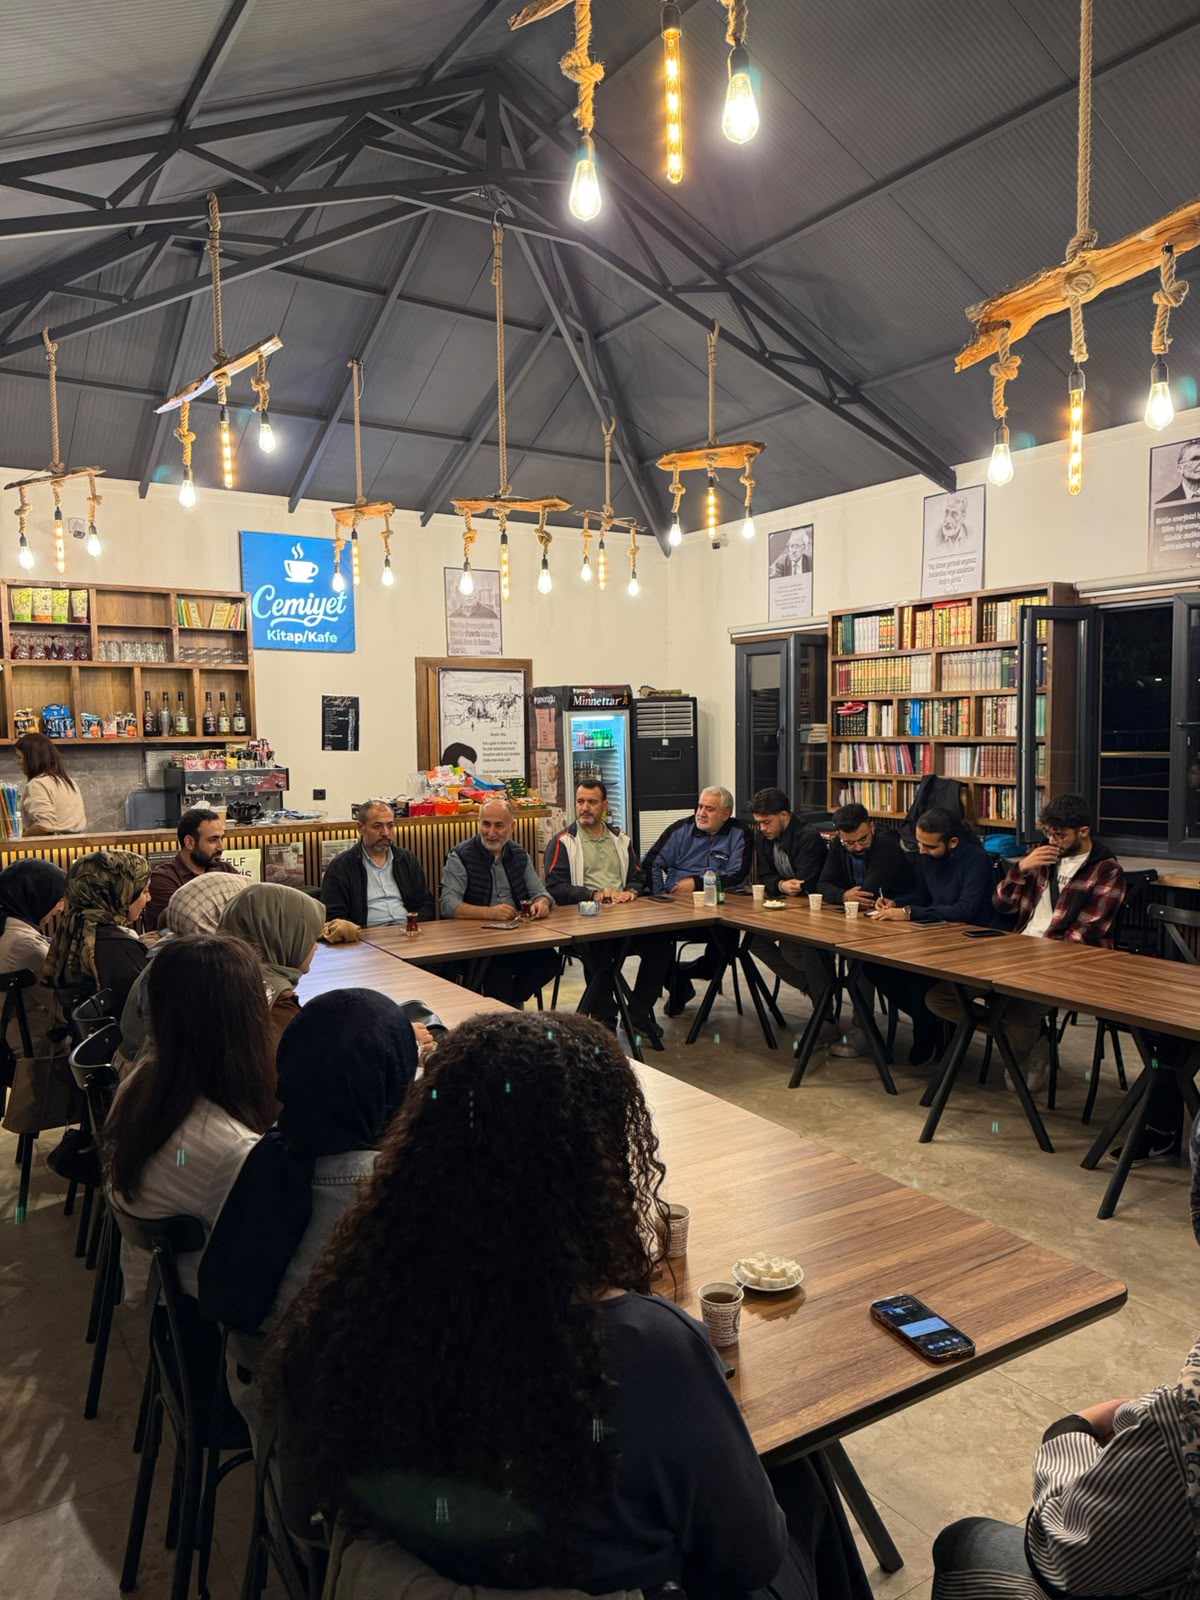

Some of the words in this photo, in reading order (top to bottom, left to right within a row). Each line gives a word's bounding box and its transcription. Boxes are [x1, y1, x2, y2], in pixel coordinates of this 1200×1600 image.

[252, 584, 348, 627] Cemiyet
[267, 629, 338, 644] Kitap/Kafe
[573, 695, 623, 706] Minnettar
